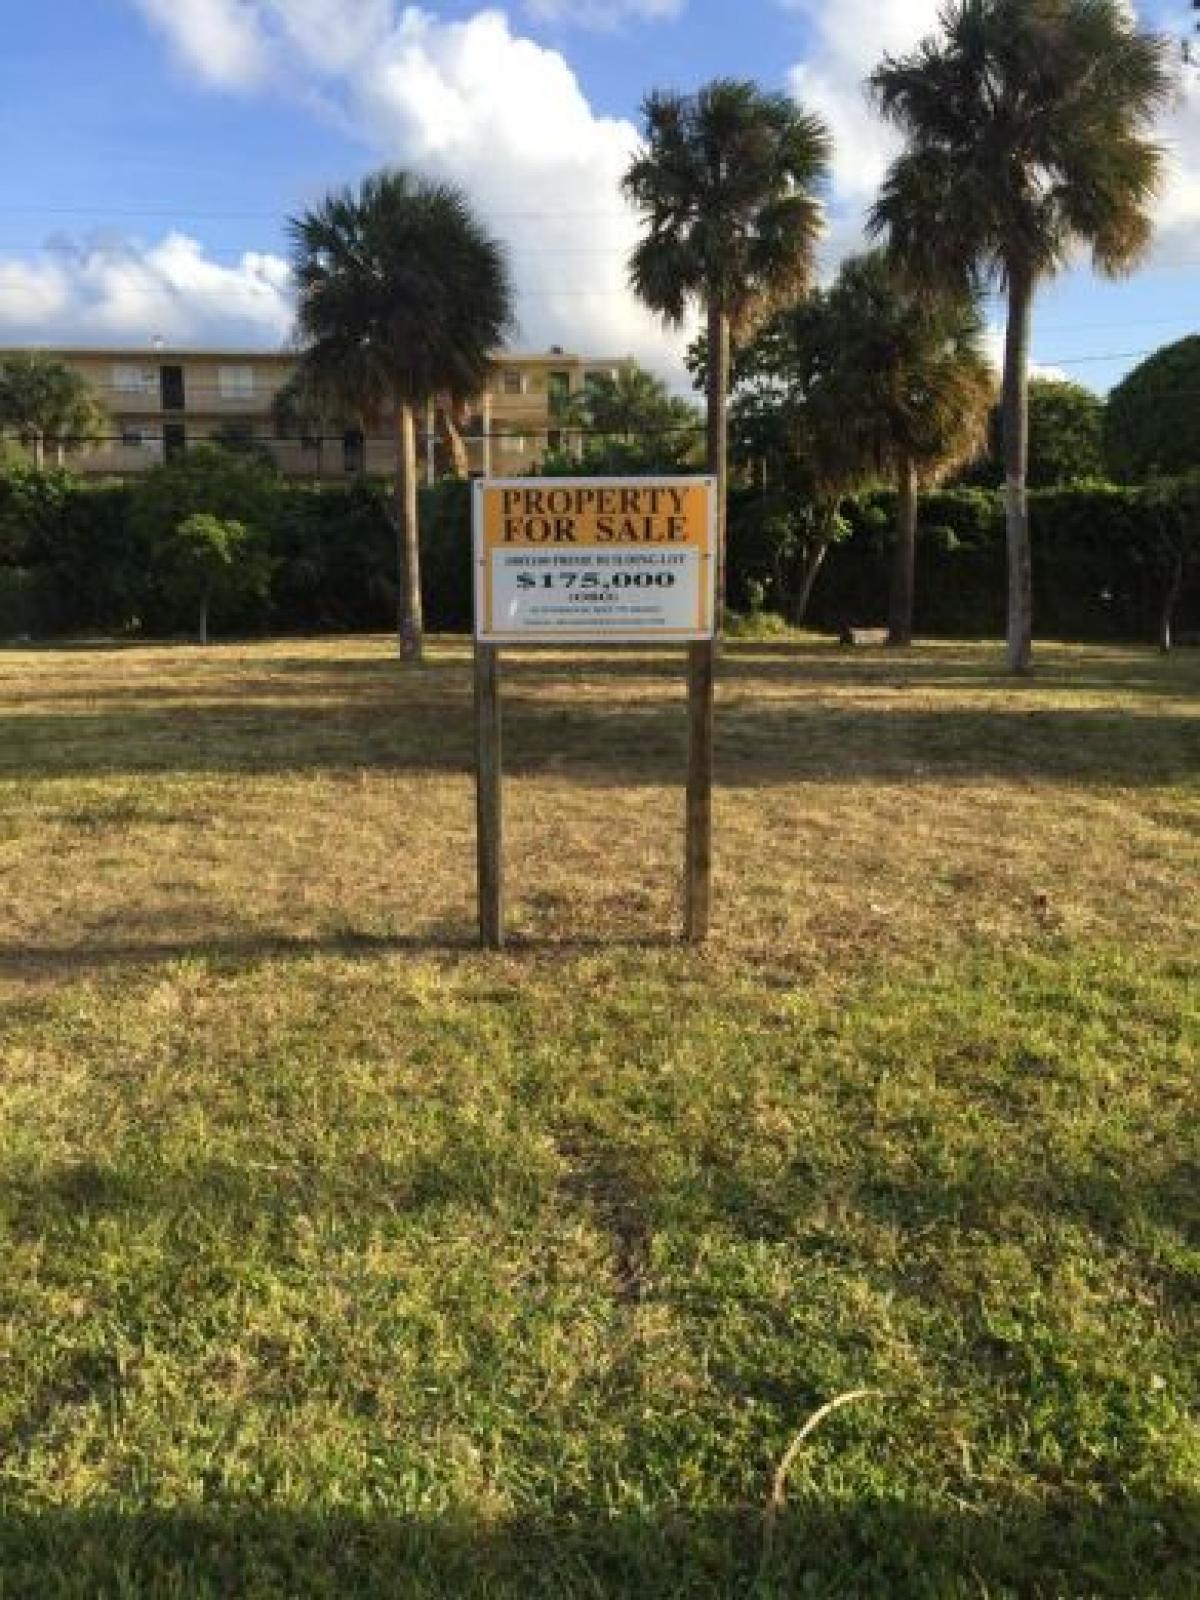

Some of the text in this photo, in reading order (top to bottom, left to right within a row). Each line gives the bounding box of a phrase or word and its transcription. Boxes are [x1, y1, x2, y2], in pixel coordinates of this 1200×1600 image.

[502, 488, 690, 515] PROPERTY
[504, 516, 687, 542] FOR SALE
[516, 571, 676, 590] $175,000
